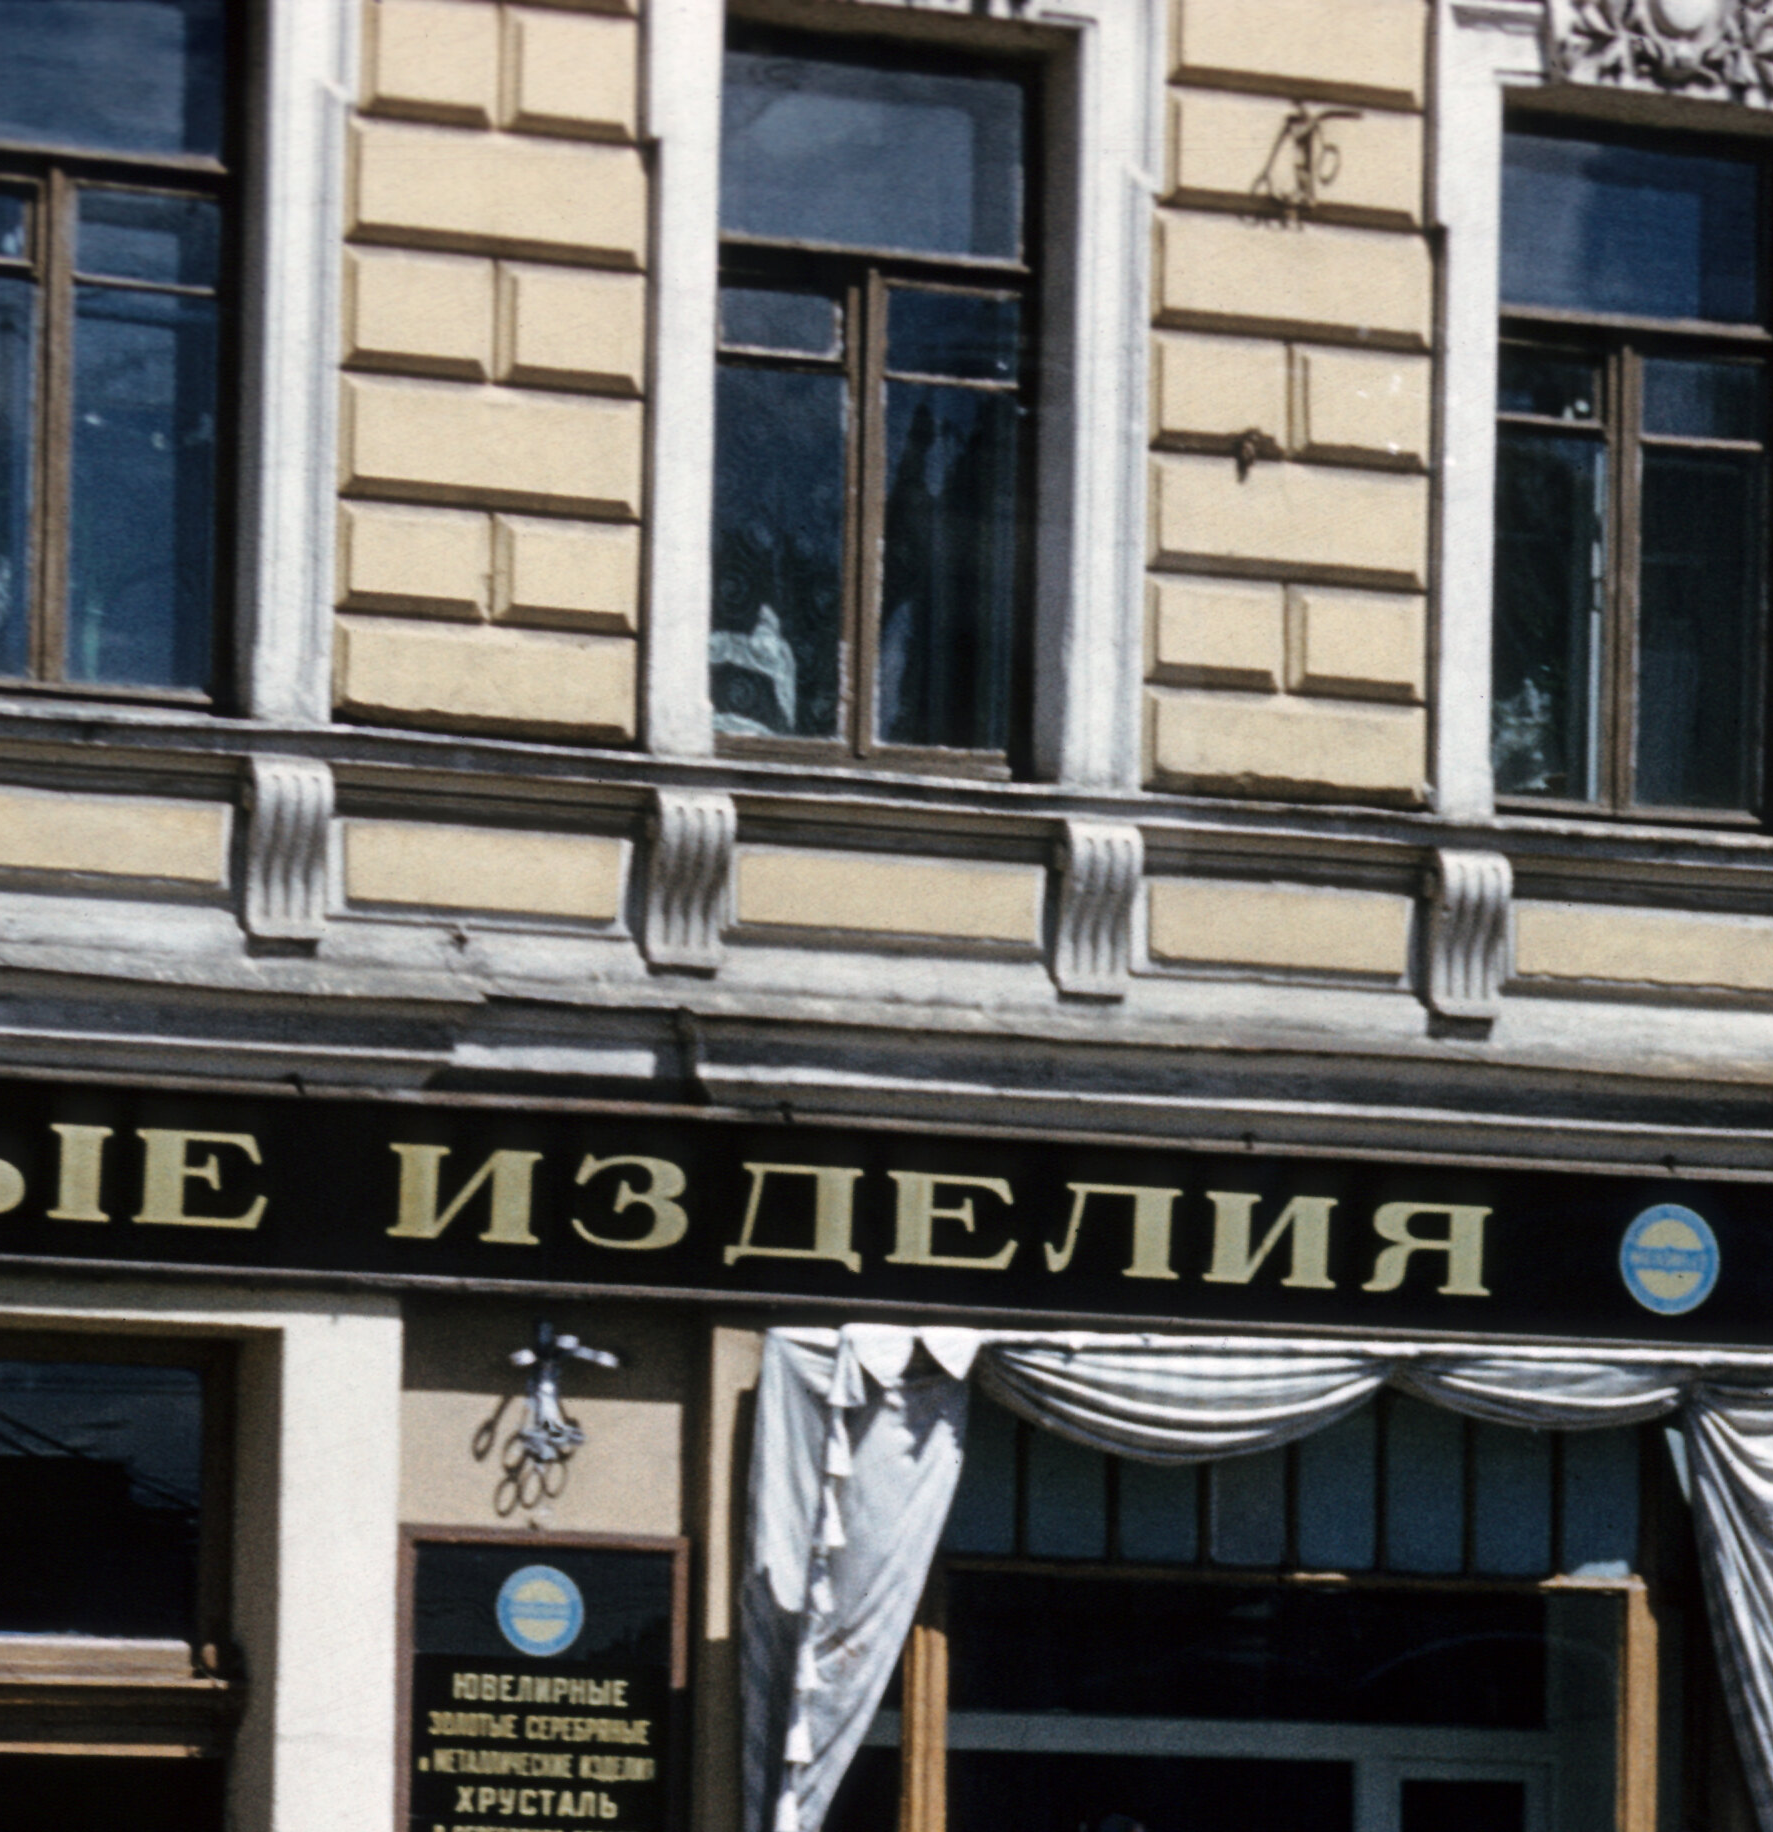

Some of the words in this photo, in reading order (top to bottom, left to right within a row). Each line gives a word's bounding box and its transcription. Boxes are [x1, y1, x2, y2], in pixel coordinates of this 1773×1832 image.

[384, 1141, 1495, 1299] ИЗДЕЛИЯ
[453, 1672, 629, 1707] ЮВЕЛИРНЫЕ
[428, 1711, 518, 1739] ЗОЛОТЫЕ
[525, 1715, 651, 1745] СЕРЕБРЯНЫЕ
[456, 1786, 618, 1819] ХРУСТАЛЬ
